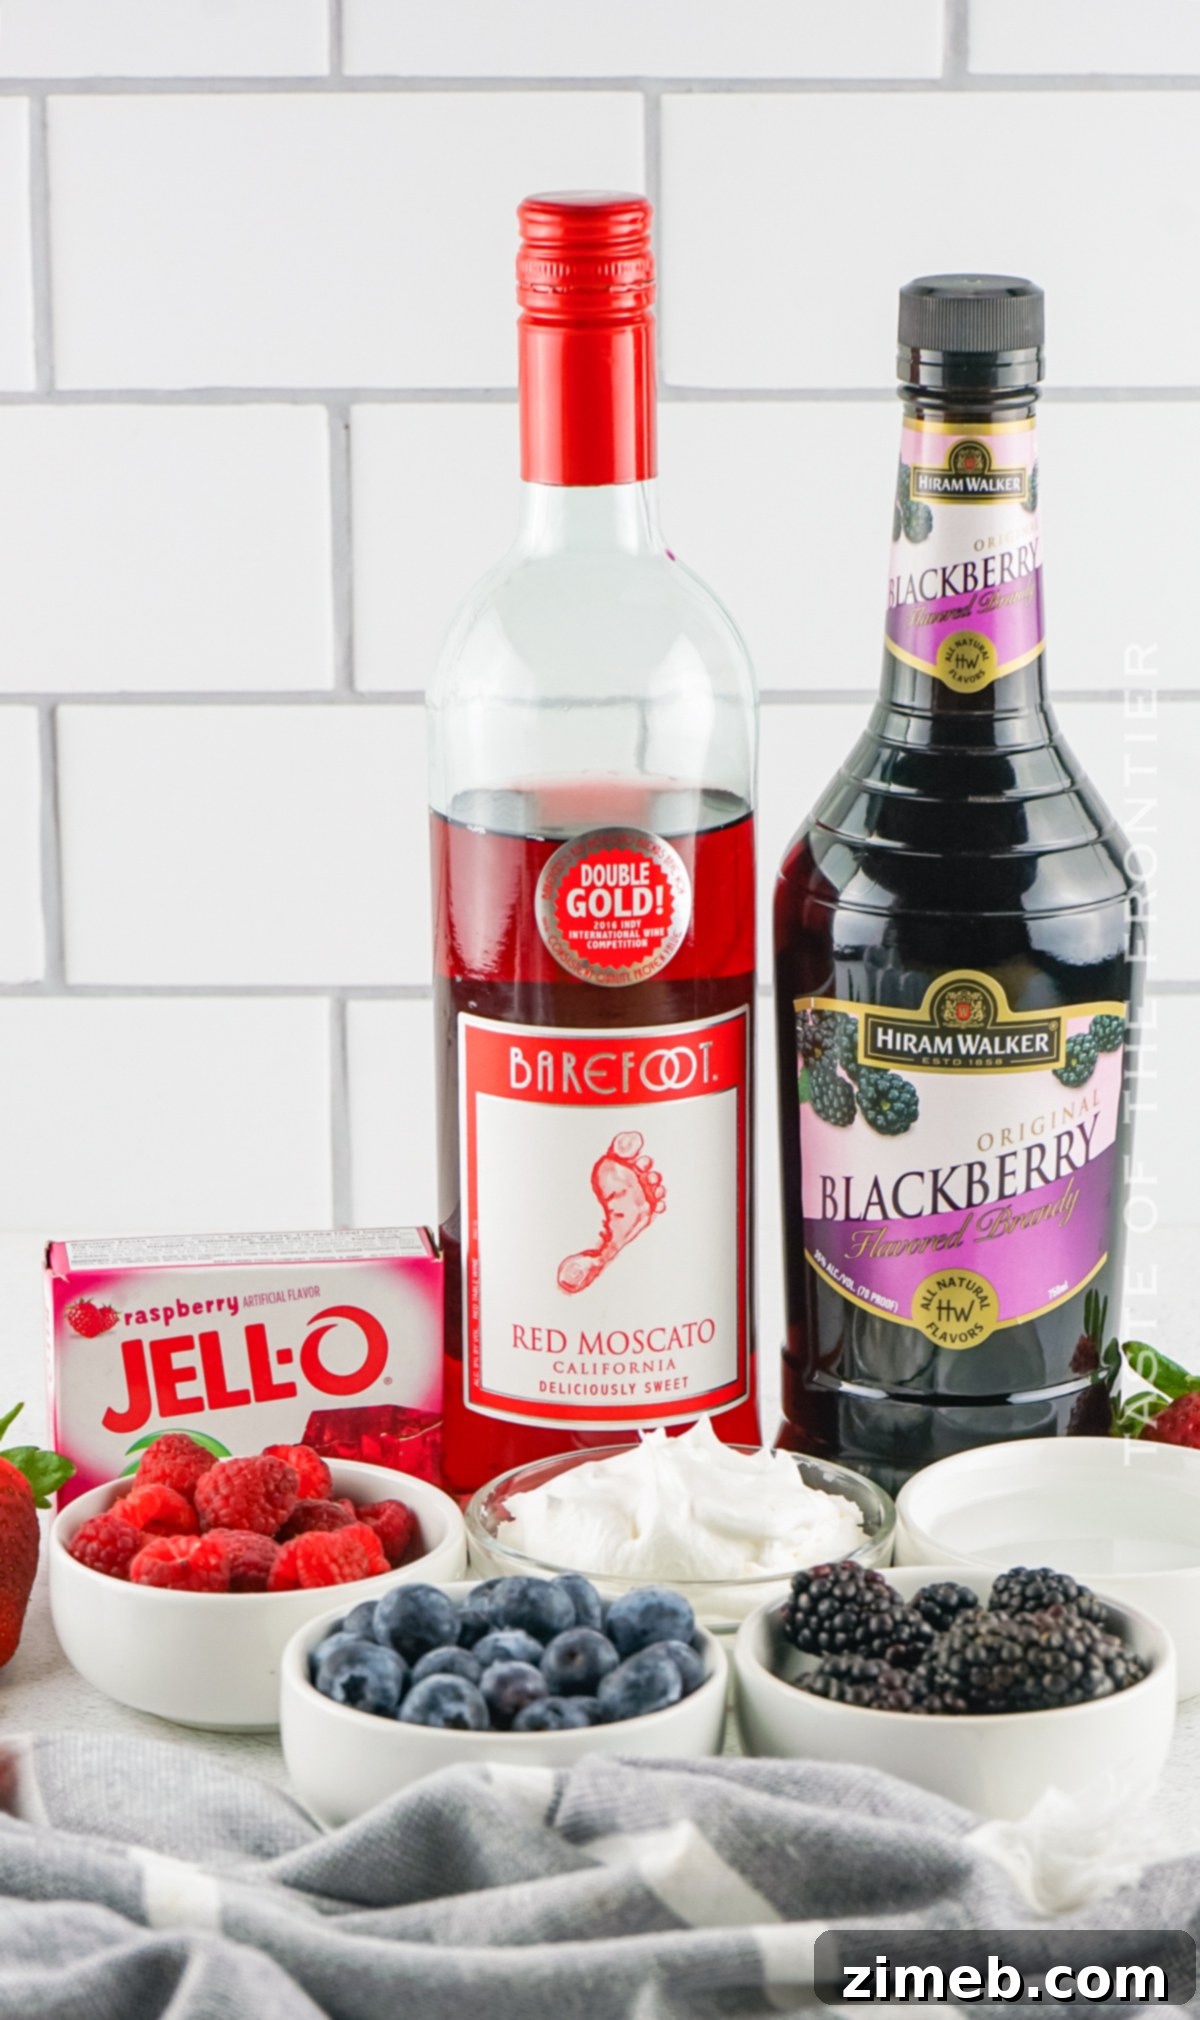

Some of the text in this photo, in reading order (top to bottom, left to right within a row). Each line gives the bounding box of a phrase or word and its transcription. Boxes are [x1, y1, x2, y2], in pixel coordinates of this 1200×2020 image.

[918, 474, 1021, 493] HIRAM WALKER
[888, 537, 1040, 609] BLACKBERRY
[909, 593, 977, 627] Flavored
[945, 638, 989, 662] ALL NATURAL
[955, 653, 980, 669] HW
[580, 862, 650, 887] DOUBLE
[566, 885, 665, 919] GOLD!
[568, 927, 665, 940] INTERNATIONAL WINE
[593, 919, 642, 930] 2016 INDY
[586, 938, 648, 950] COMPETITION
[877, 1027, 1049, 1056] HIRAM WALKER
[921, 1057, 962, 1066] ESTD
[976, 1089, 1100, 1152] ORIGINAL
[820, 1111, 1101, 1222] BLACKBERRY
[844, 1175, 1080, 1260] Flavored Brandy
[124, 1284, 321, 1327] raspberry ARTIFICIAL FLAVOR
[920, 1276, 991, 1312] ALL NATURAL
[936, 1299, 976, 1322] HW
[511, 1318, 716, 1356] RED MOSCATO
[925, 1321, 985, 1344] FLAVORS
[101, 1304, 389, 1434] JELL-O
[553, 1358, 677, 1375] CALIFORNIA
[539, 1376, 689, 1396] DELICIOUSLY SWEET
